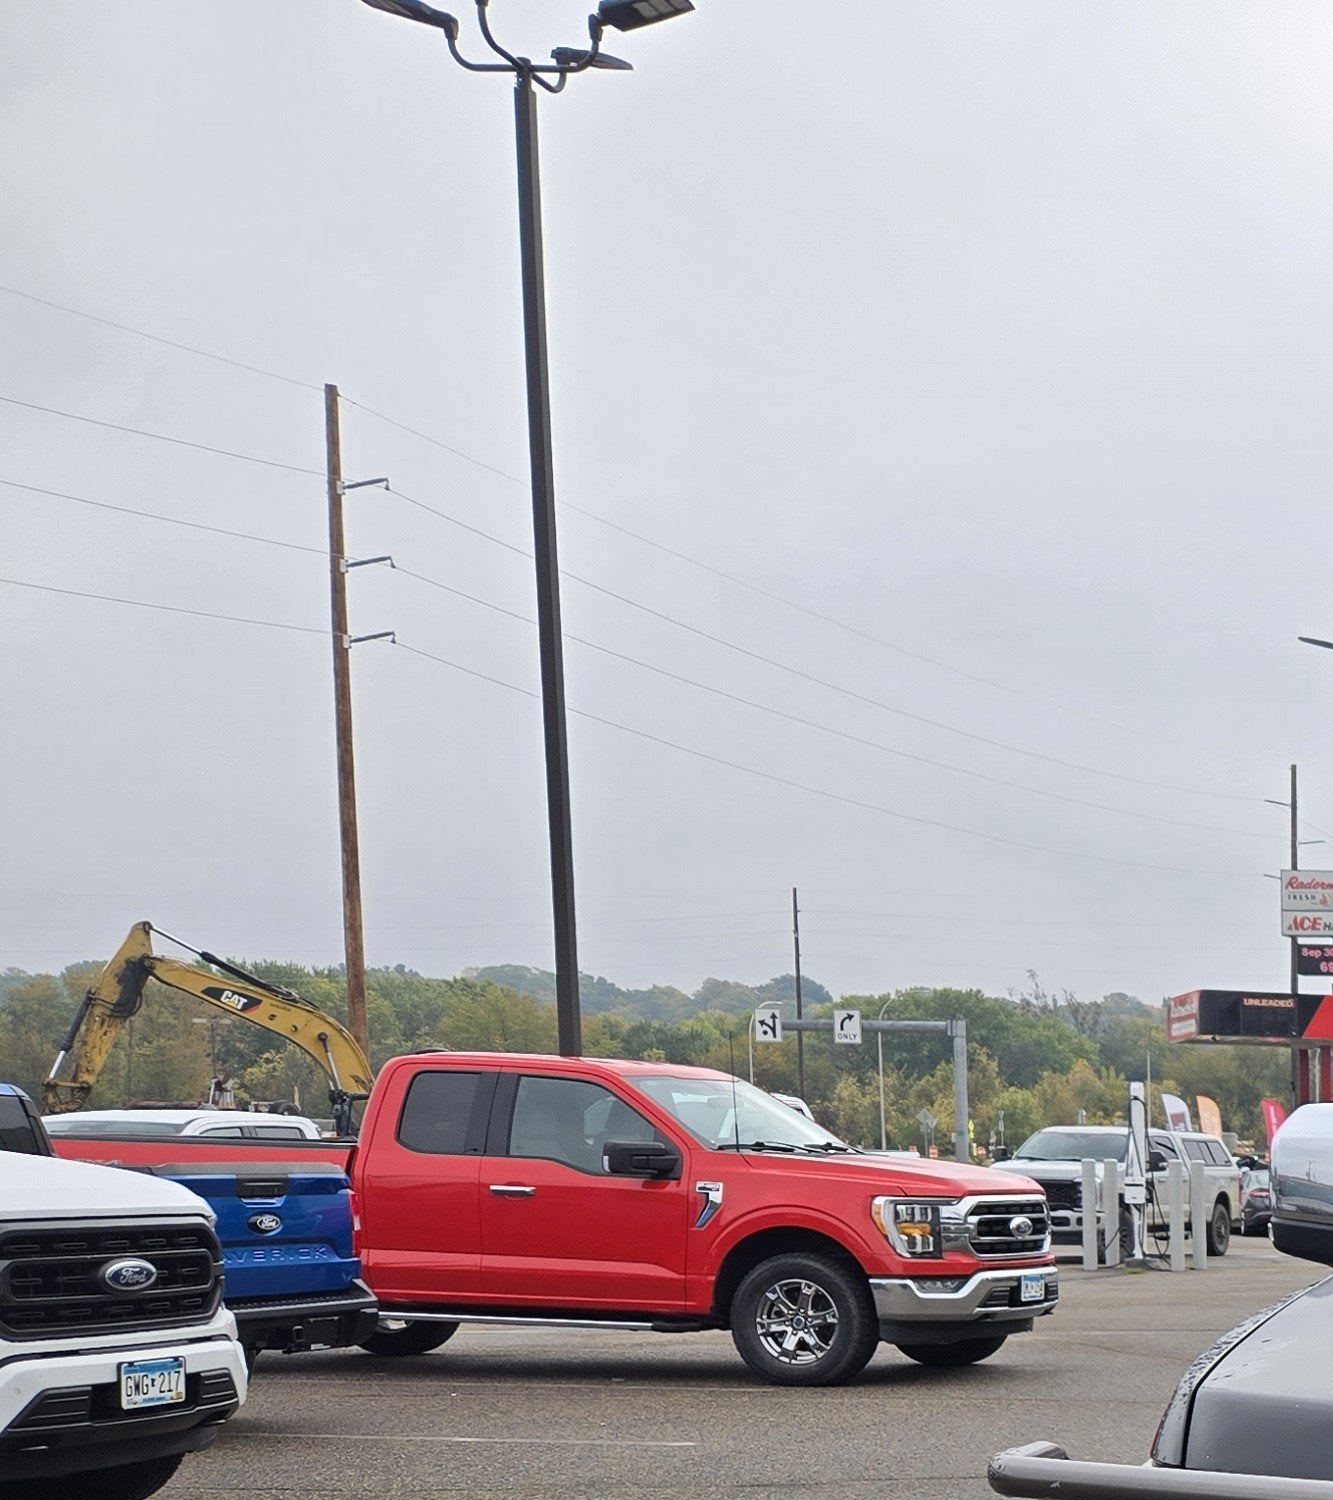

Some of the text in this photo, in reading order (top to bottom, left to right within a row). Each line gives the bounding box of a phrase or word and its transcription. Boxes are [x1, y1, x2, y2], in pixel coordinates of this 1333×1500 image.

[1287, 915, 1323, 931] ACE
[1301, 947, 1321, 959] Sep
[220, 990, 248, 1010] CAT
[838, 1033, 858, 1041] ONLY
[120, 1267, 147, 1283] Ford
[125, 1370, 181, 1397] GWG 217
